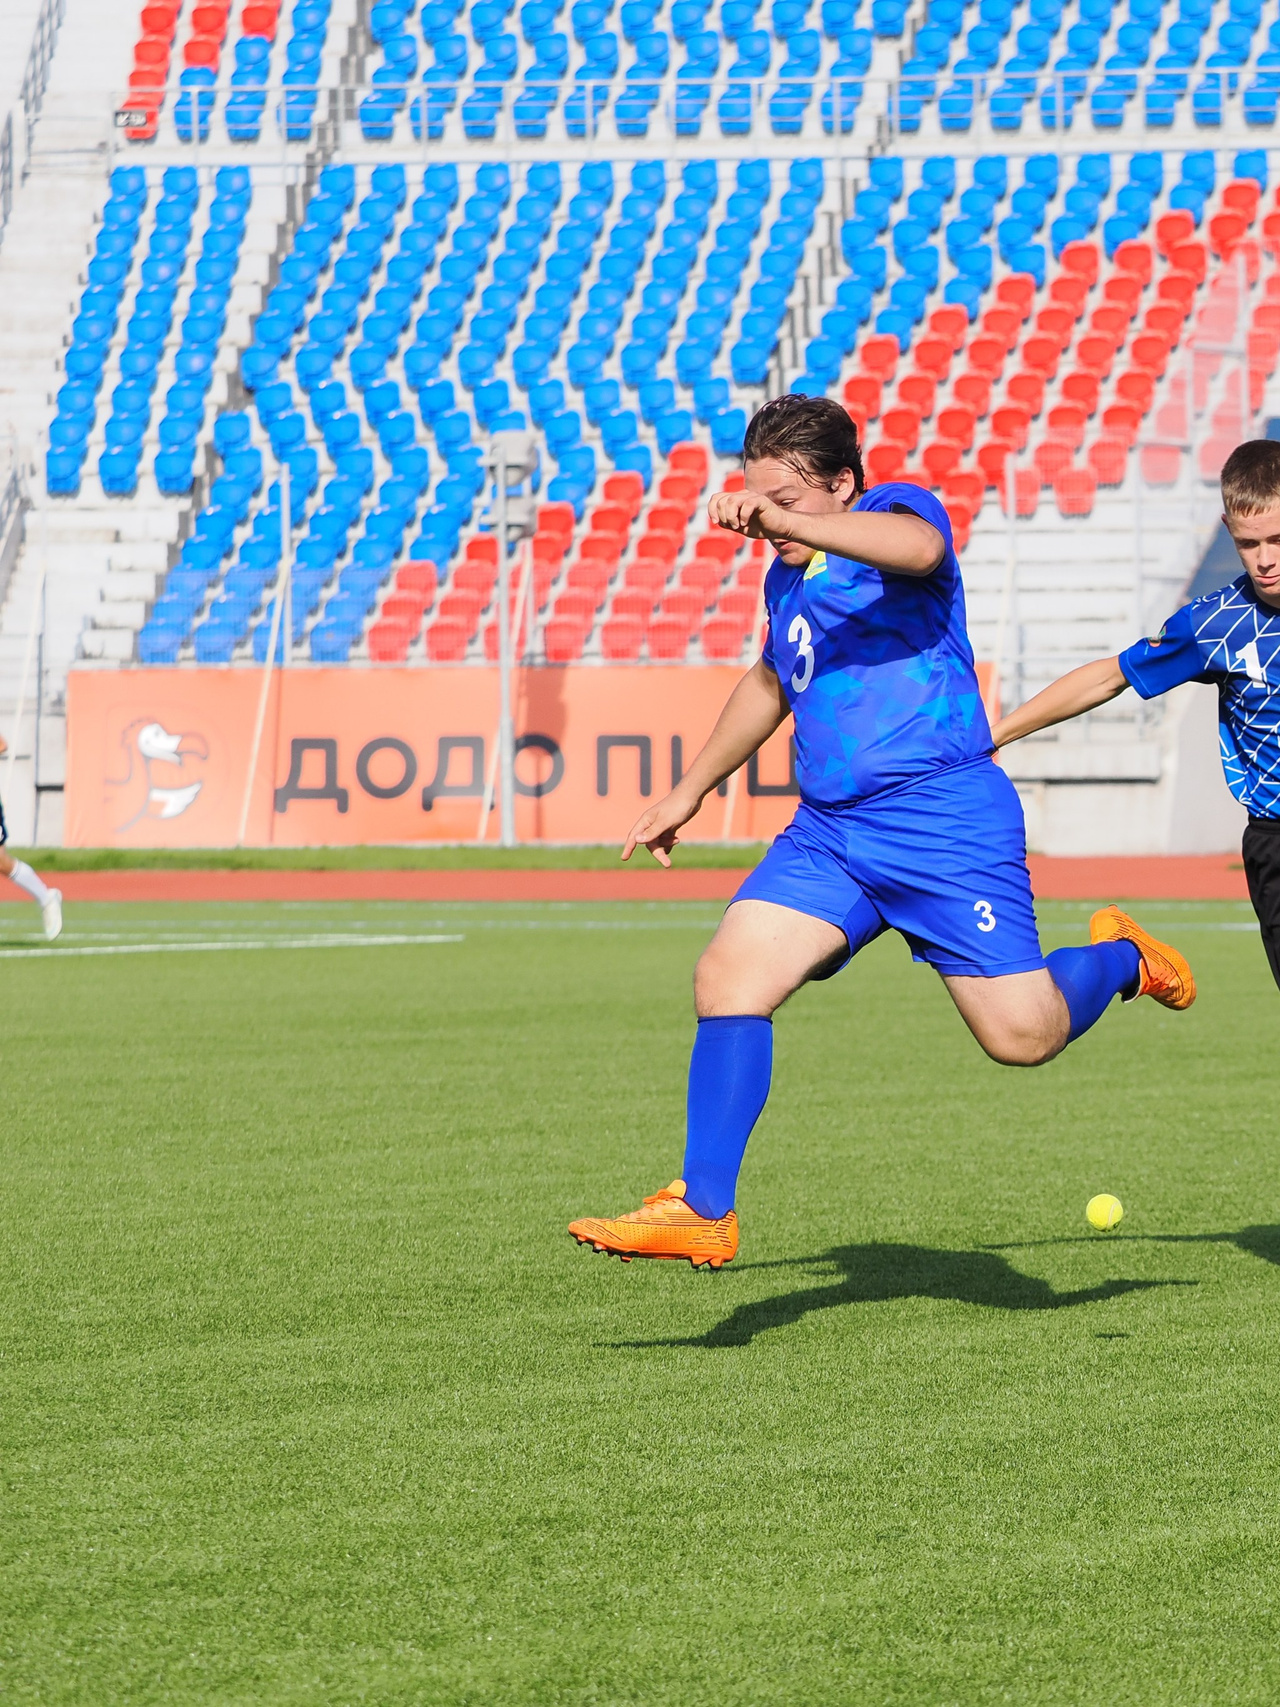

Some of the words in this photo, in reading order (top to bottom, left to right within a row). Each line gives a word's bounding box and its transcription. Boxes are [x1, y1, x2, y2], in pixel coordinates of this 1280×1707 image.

[787, 613, 815, 694] 3
[1235, 642, 1266, 689] 1
[273, 732, 566, 813] ДОДО
[973, 900, 997, 933] 3
